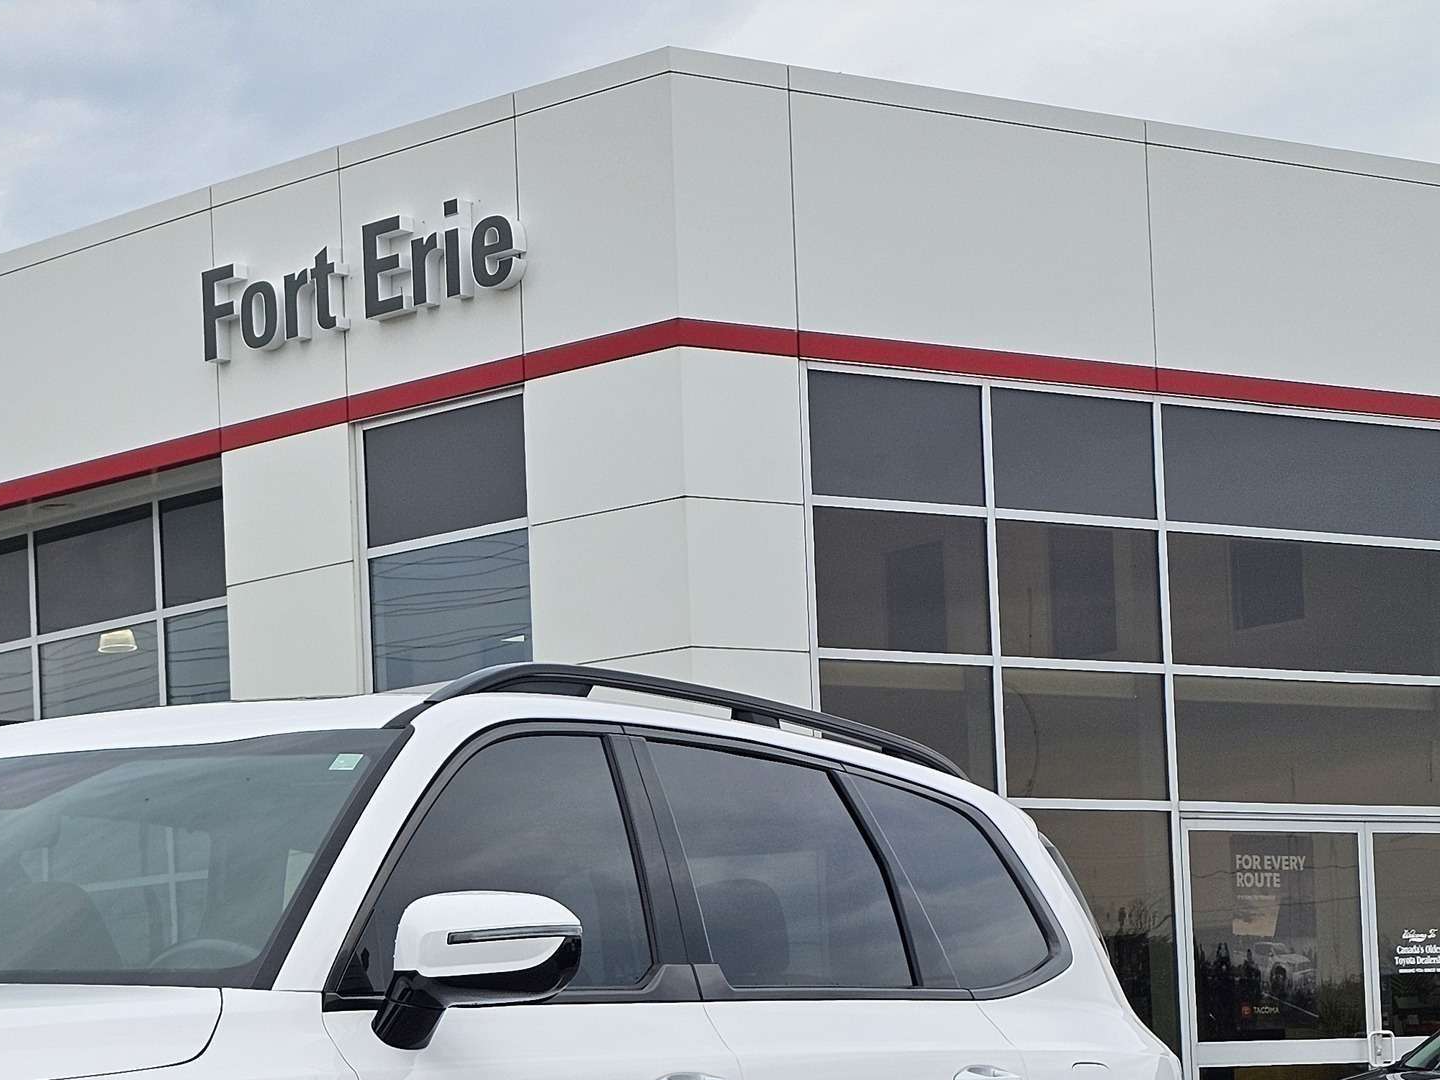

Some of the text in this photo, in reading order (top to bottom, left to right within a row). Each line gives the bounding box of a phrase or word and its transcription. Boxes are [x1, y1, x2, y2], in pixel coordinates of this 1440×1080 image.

[201, 198, 523, 363] Fort Erie
[1235, 854, 1306, 871] FOR EVERY
[1236, 871, 1281, 888] ROUTE
[1394, 956, 1416, 967] Toyota
